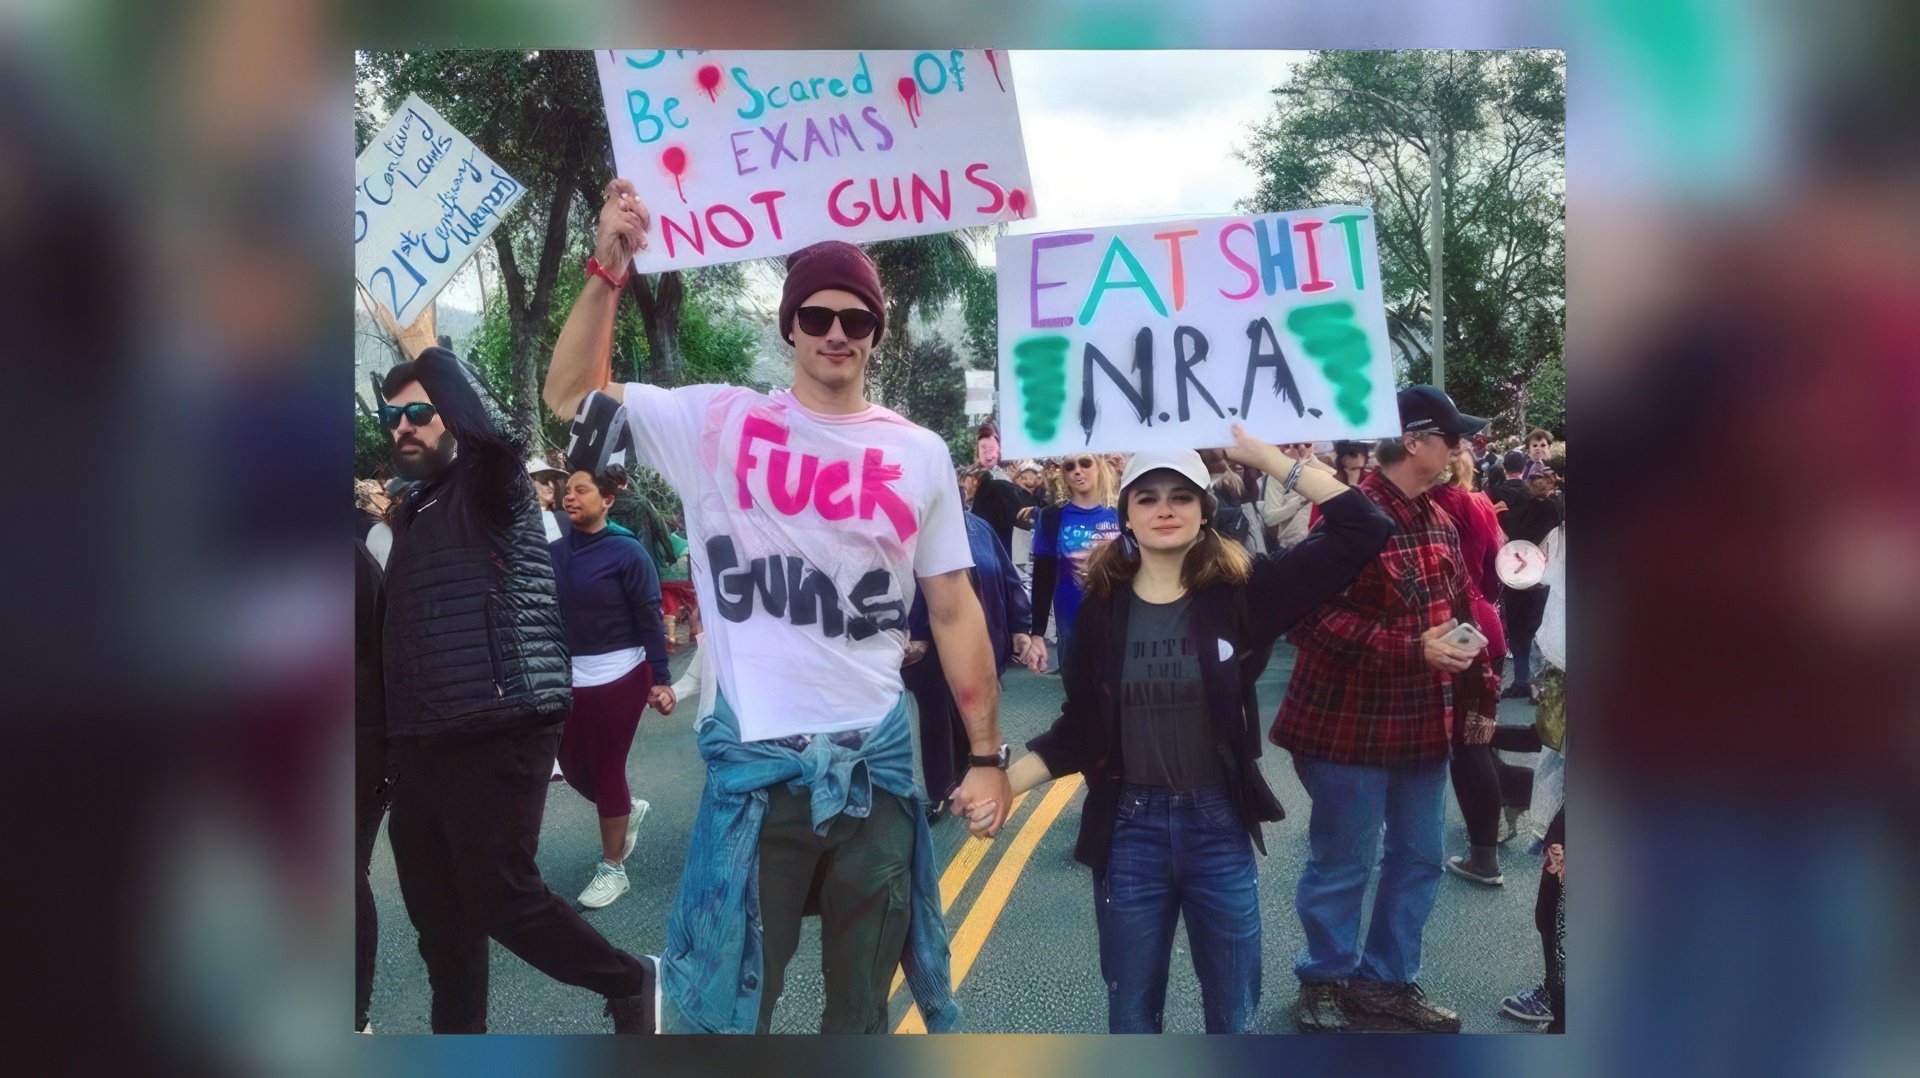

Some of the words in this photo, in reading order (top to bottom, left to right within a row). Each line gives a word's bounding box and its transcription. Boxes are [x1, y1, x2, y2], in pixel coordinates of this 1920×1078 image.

[626, 89, 689, 144] Be
[730, 52, 873, 120] Scared
[731, 106, 894, 176] EXAMS
[661, 190, 787, 259] NOT
[1030, 229, 1199, 329] EAT
[1218, 214, 1369, 301] SHIT
